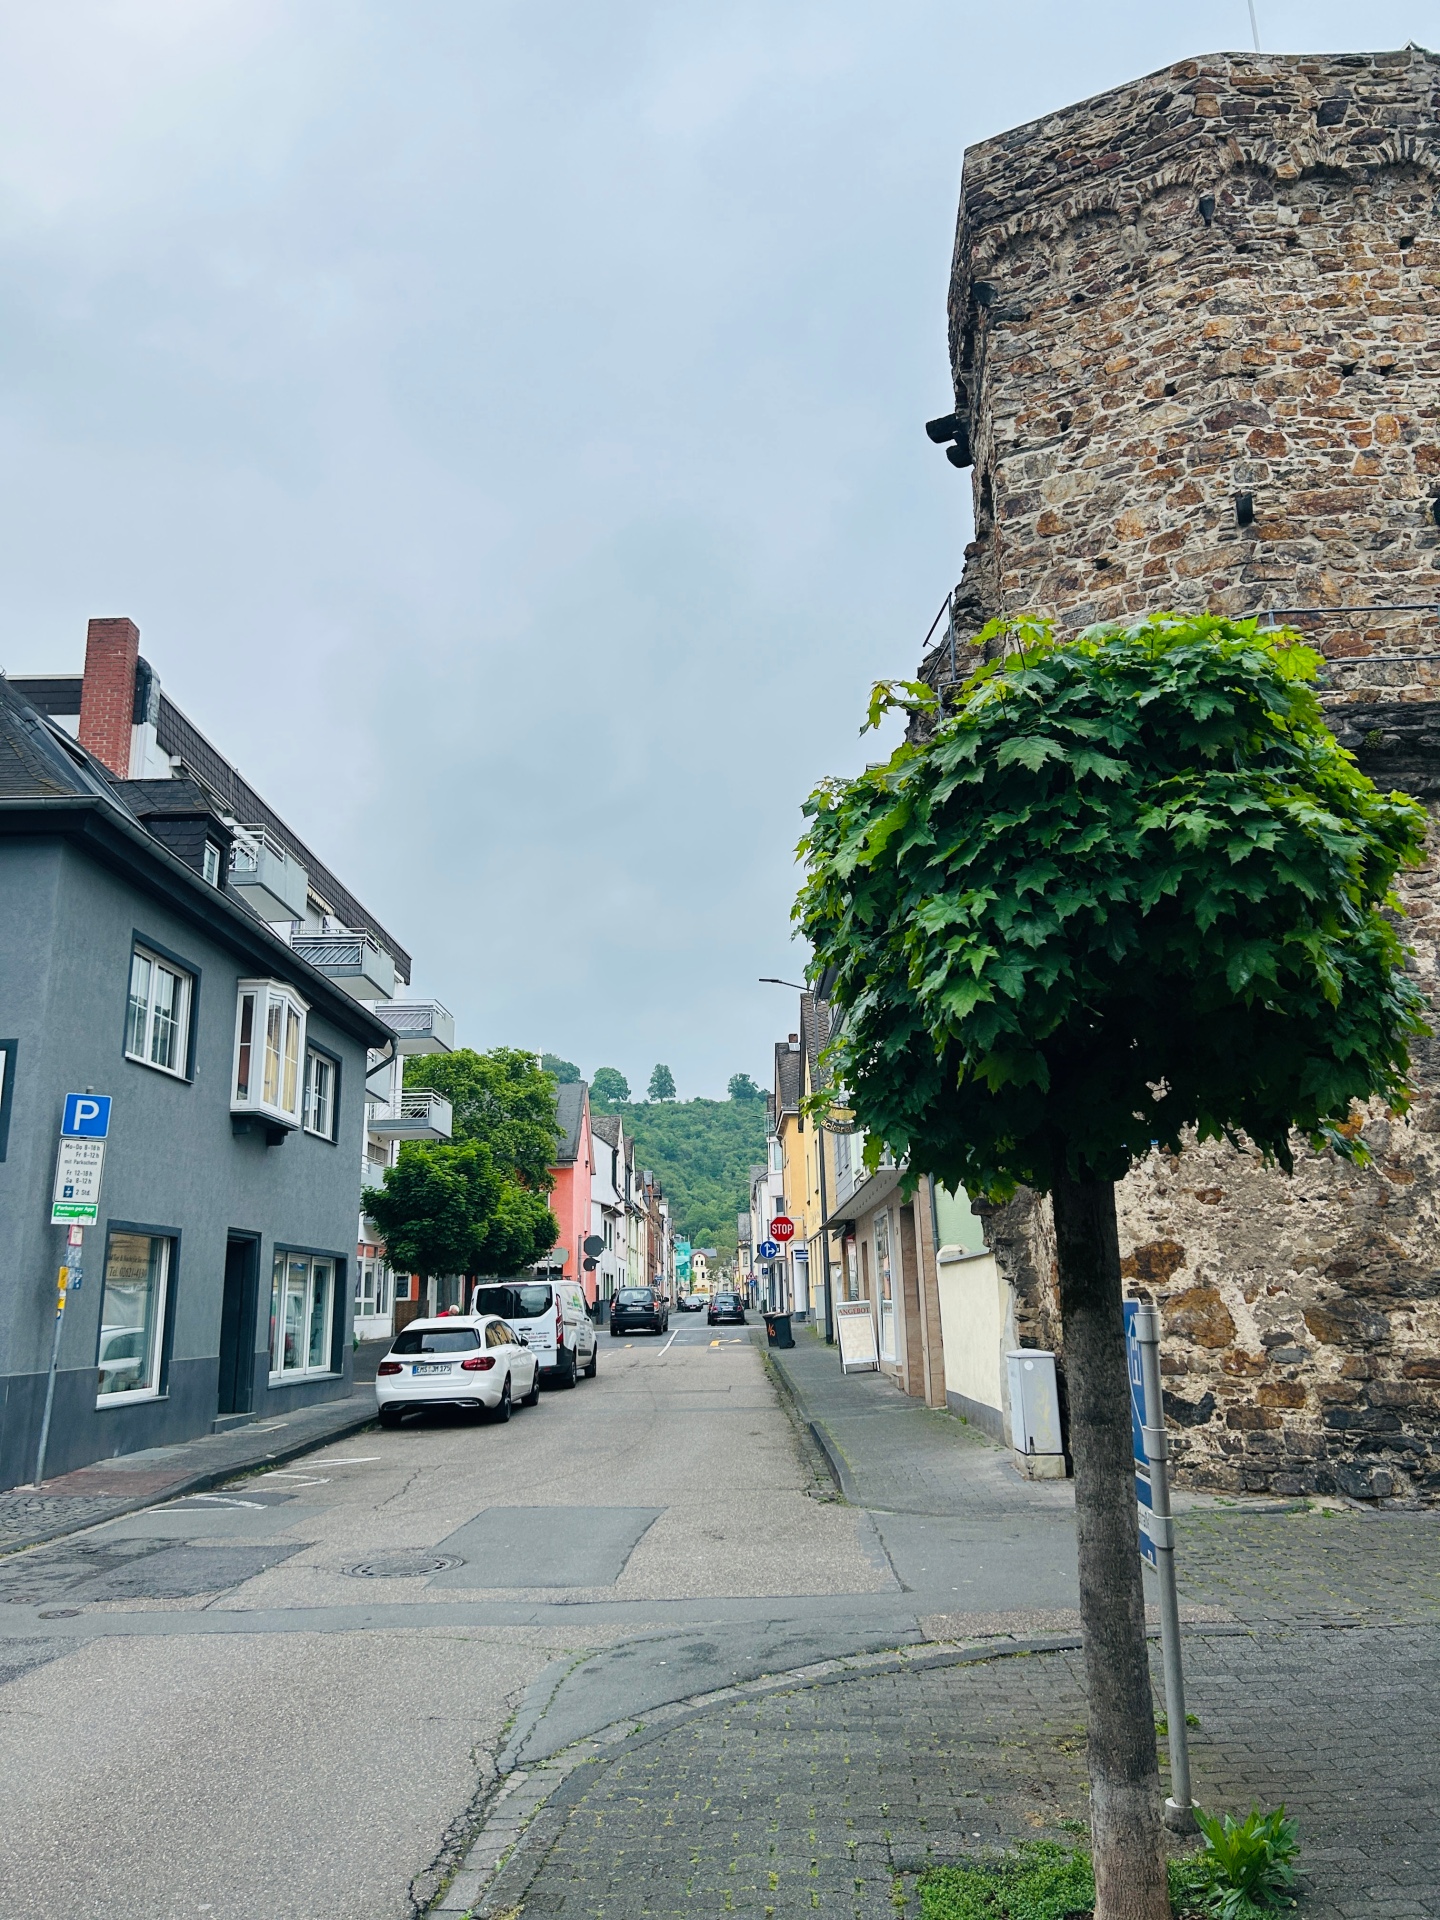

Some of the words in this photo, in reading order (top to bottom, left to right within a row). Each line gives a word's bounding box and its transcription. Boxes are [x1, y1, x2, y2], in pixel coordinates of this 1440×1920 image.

[73, 1099, 100, 1131] P
[820, 1116, 854, 1133] äckerei
[65, 1143, 83, 1151] Mo-Do
[771, 1223, 793, 1235] STOP
[838, 1306, 870, 1317] ANGEBOT
[417, 1366, 428, 1374] EMS
